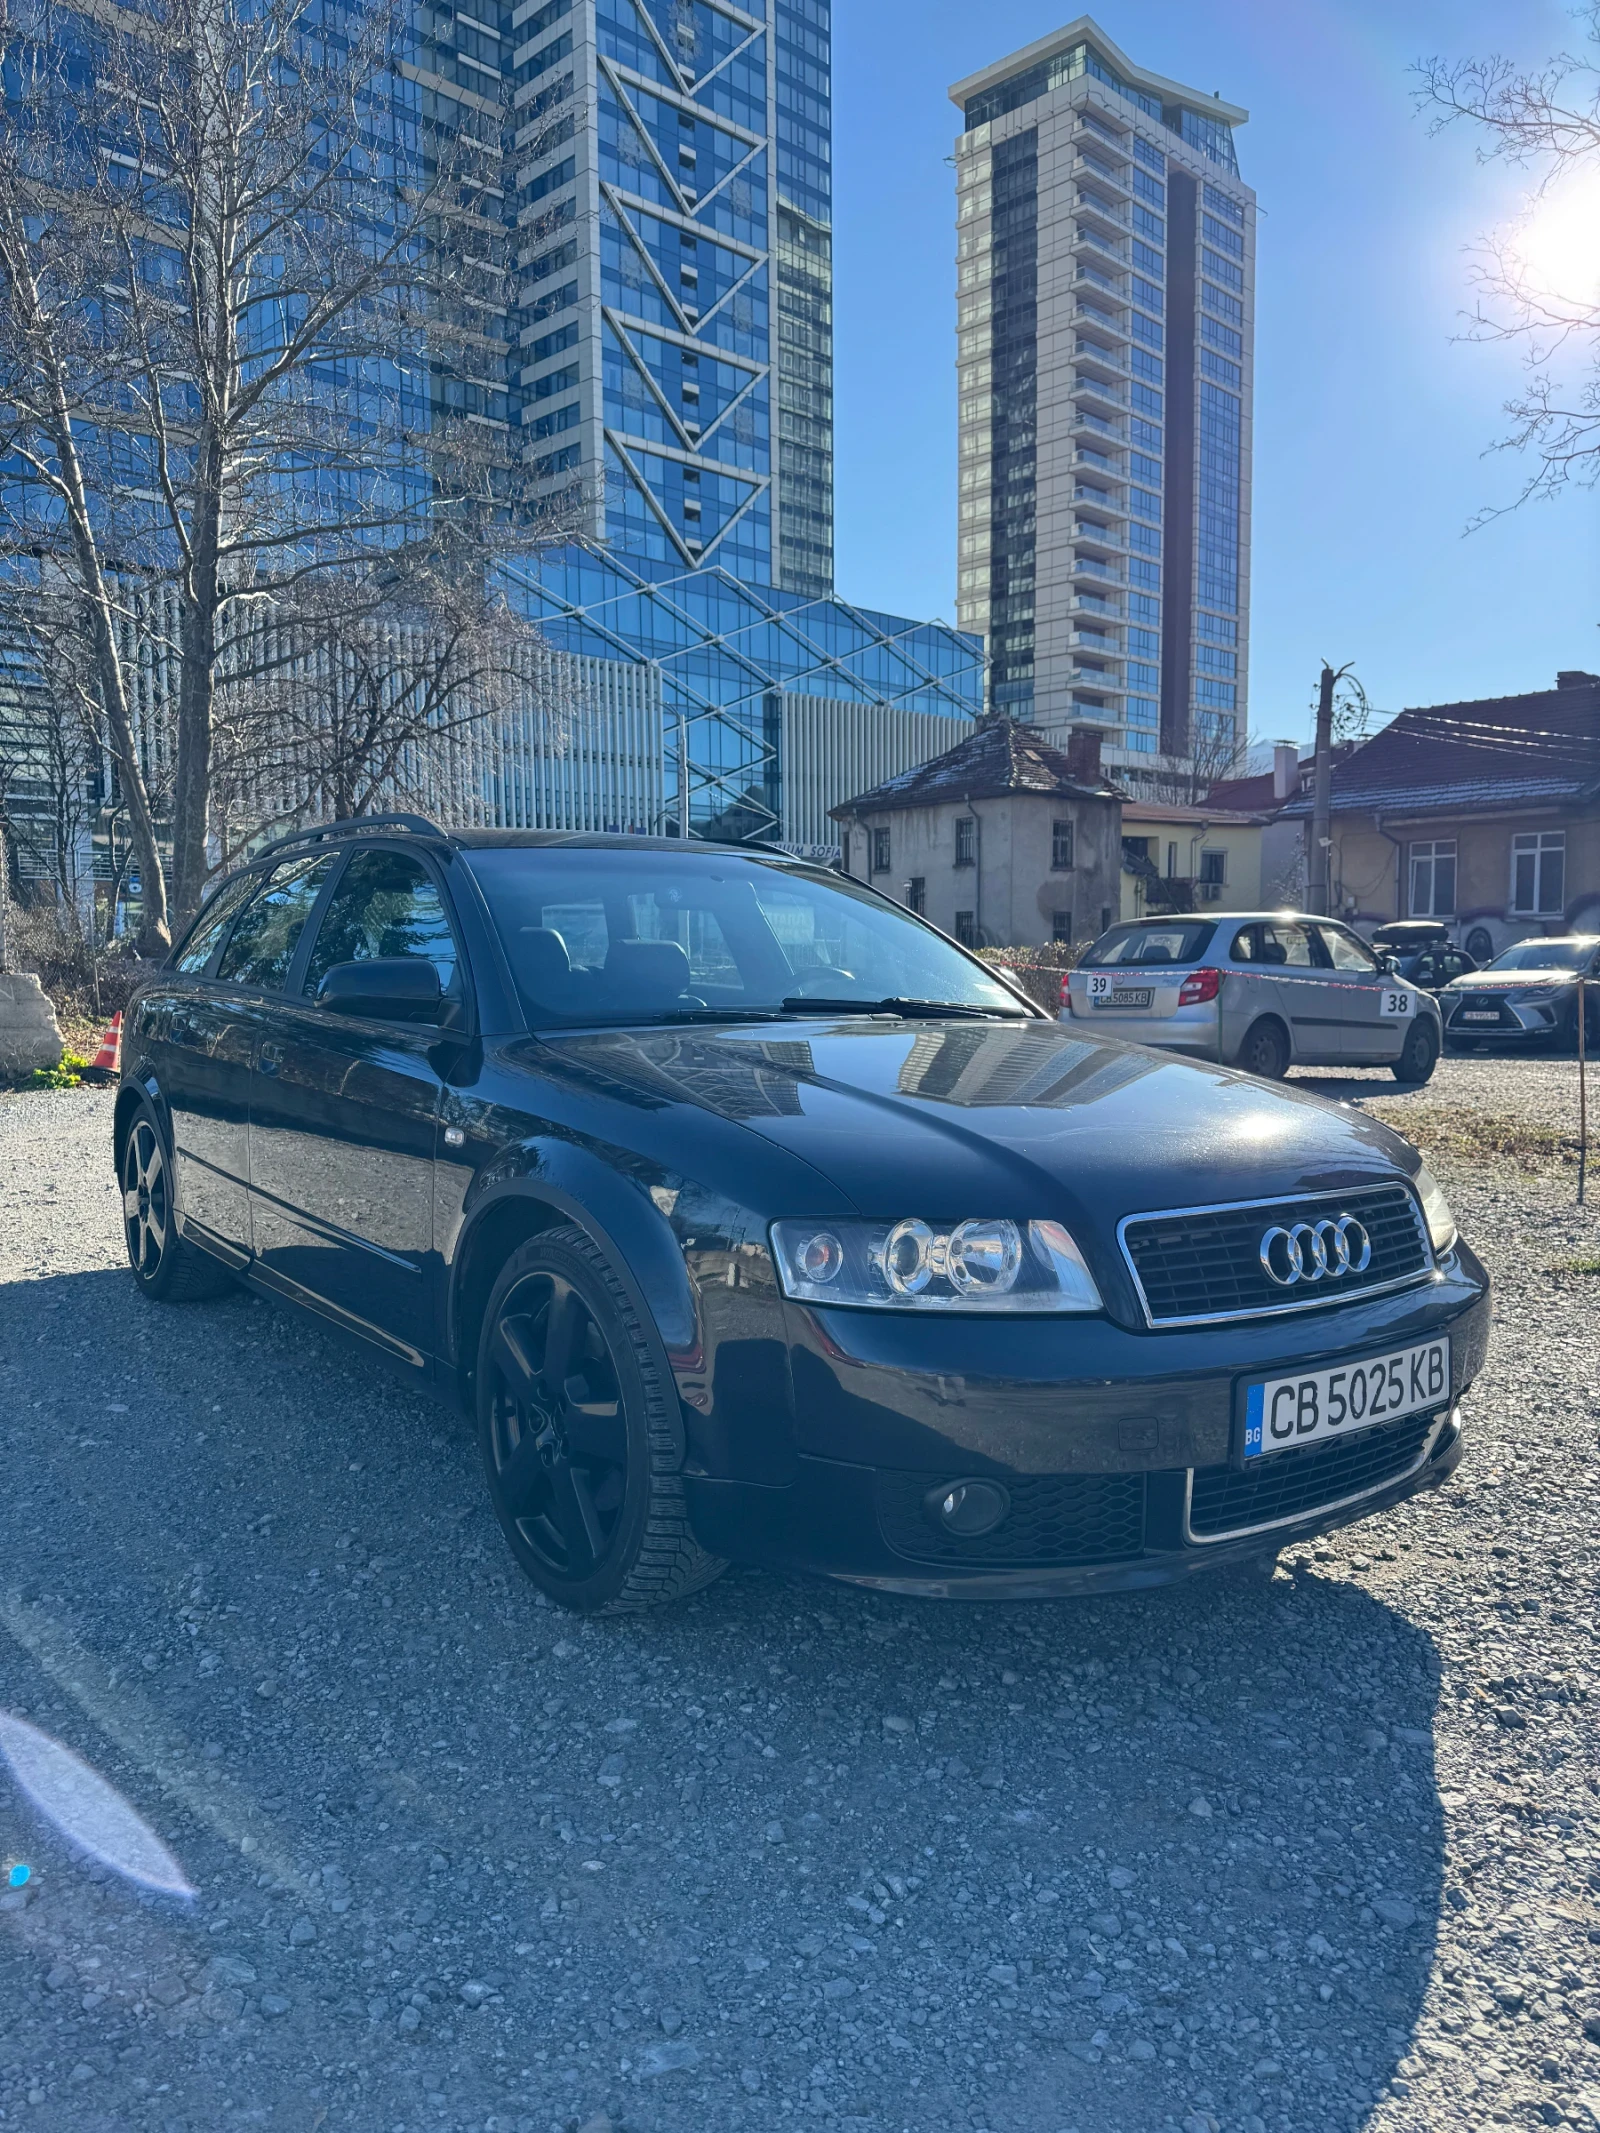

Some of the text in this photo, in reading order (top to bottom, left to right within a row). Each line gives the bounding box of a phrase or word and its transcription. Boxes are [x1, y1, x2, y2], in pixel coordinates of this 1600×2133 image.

[810, 846, 841, 858] SOFIA
[1092, 977, 1107, 993] 39
[1113, 992, 1134, 1003] 5085
[1135, 992, 1147, 1003] KB
[1387, 994, 1408, 1013] 38
[1270, 1346, 1444, 1440] CB 5025 KB
[1245, 1427, 1261, 1445] BG
